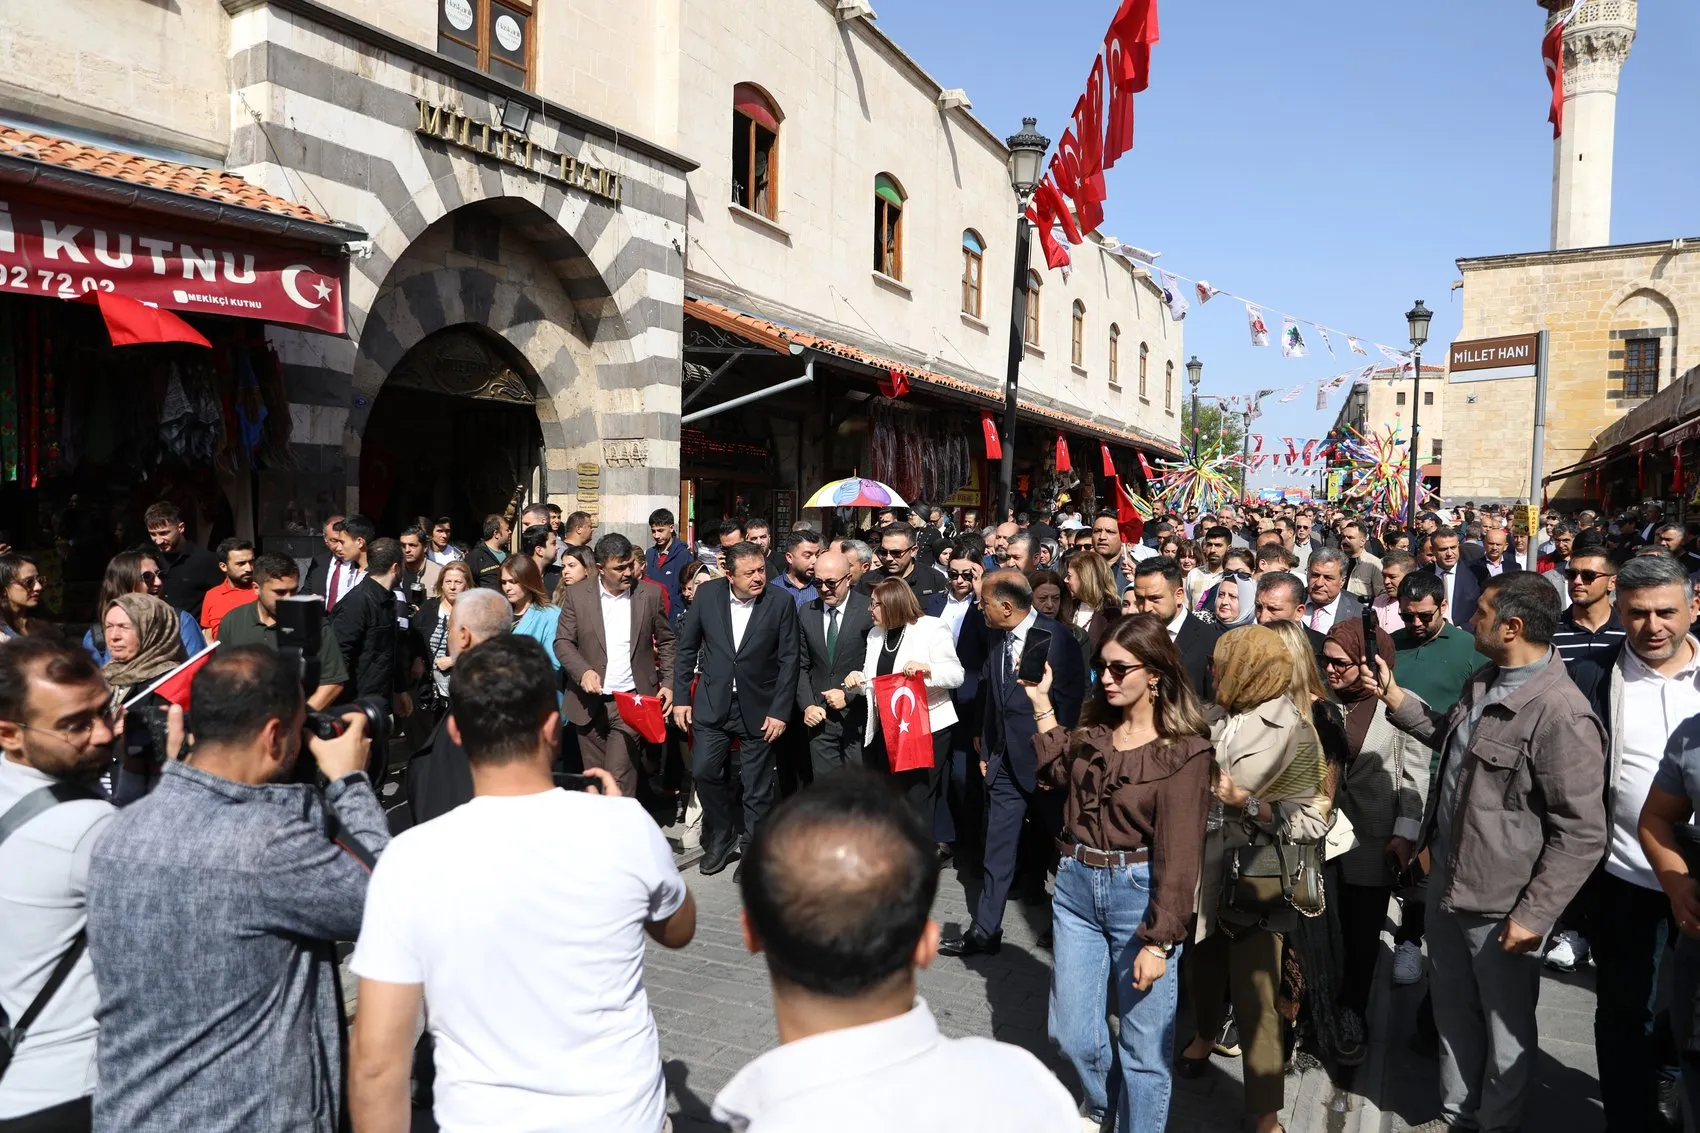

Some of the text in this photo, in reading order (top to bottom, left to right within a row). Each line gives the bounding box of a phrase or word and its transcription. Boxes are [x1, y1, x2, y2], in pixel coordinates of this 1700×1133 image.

[41, 219, 257, 285] KUTNU
[38, 270, 75, 292] 72
[187, 292, 262, 309] MEKİKÇİ KUTNU
[1454, 344, 1529, 364] MİLLET HANI
